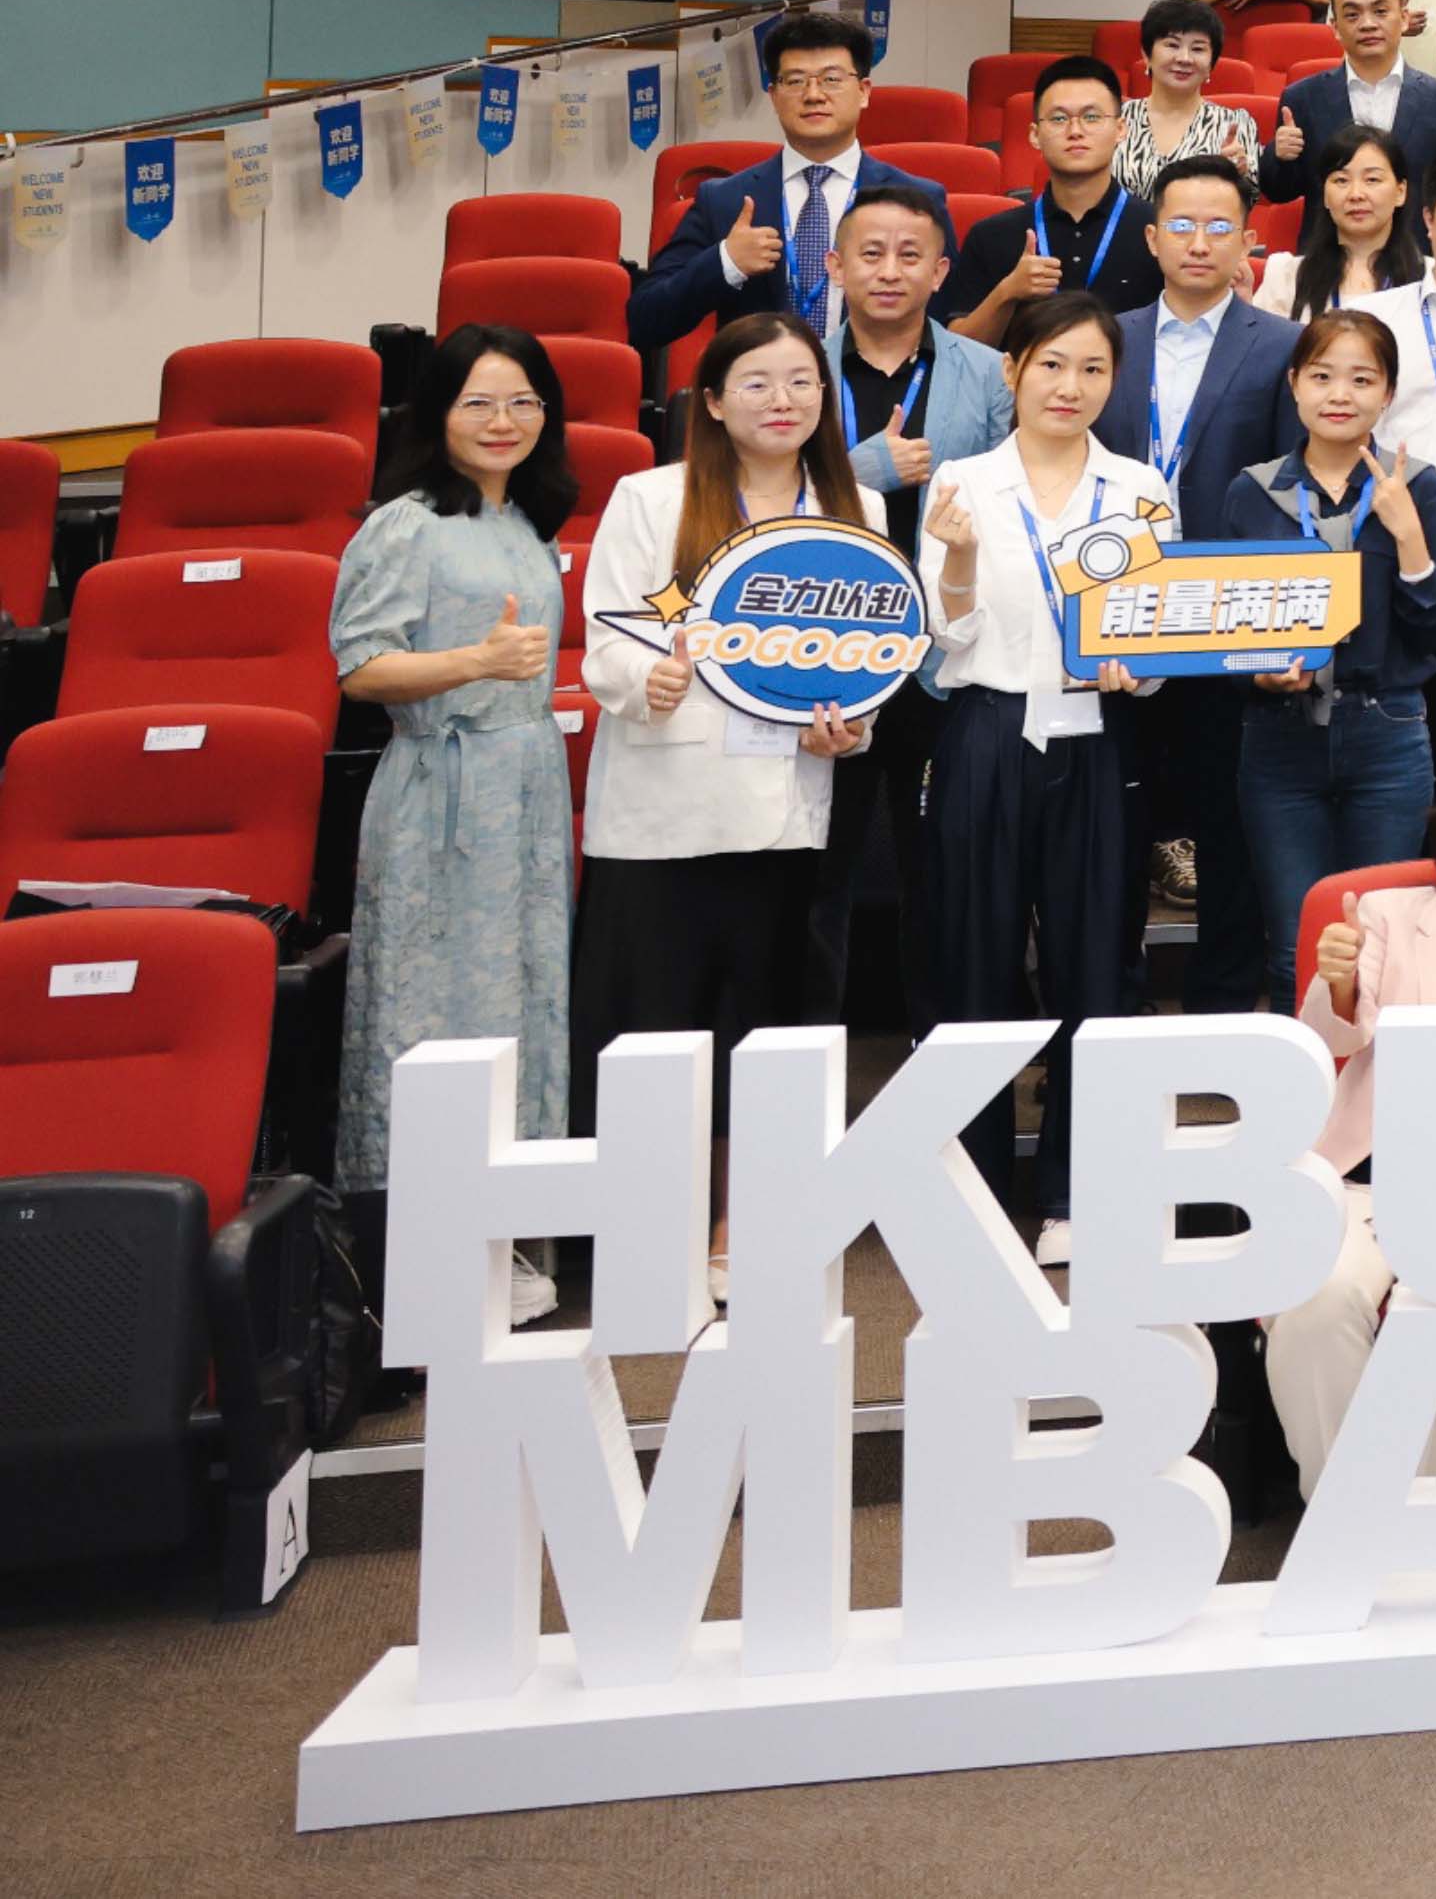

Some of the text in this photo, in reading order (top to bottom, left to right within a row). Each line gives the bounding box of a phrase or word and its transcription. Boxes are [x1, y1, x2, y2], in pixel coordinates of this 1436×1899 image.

[489, 88, 511, 106] 欢迎
[483, 106, 514, 125] 新同学
[329, 124, 353, 144] 欢迎
[327, 144, 360, 167] 新同学
[20, 169, 65, 187] WELCOME
[136, 163, 165, 182] 欢迎
[33, 188, 54, 201] NEW
[132, 183, 171, 206] 新同学
[22, 203, 64, 218] STUDENTS
[736, 575, 911, 621] 全力以赴
[1100, 577, 1332, 639] 能量满满
[19, 1208, 36, 1220] 12
[280, 1496, 300, 1577] A
